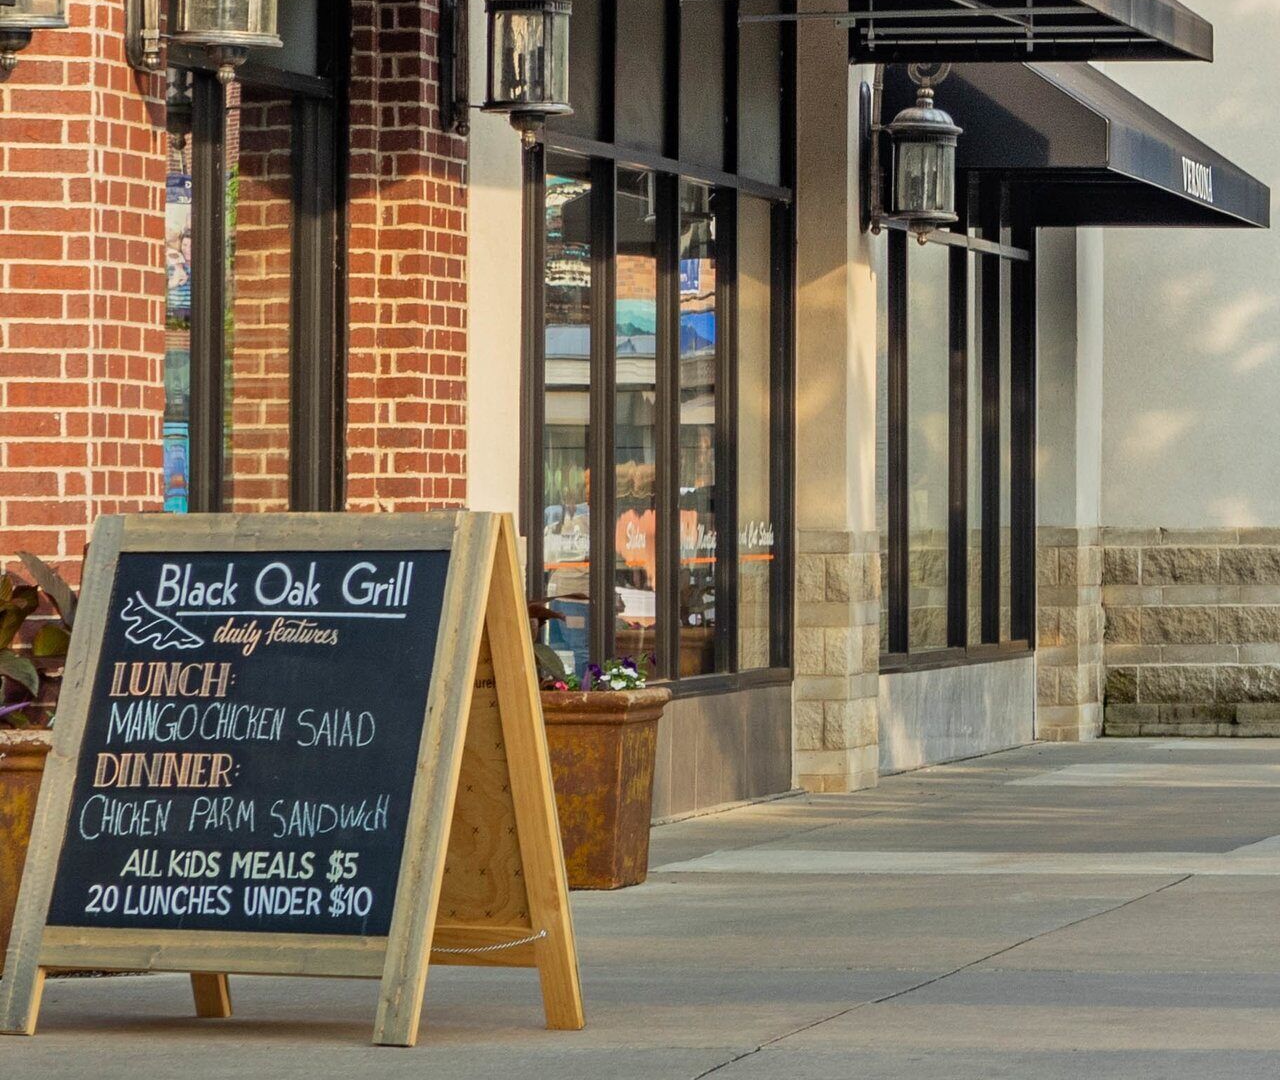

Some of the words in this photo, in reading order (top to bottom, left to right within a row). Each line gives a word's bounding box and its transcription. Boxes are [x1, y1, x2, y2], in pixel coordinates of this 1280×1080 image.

[1181, 155, 1214, 204] VERSONA
[155, 562, 239, 608] Black
[254, 561, 321, 607] Oak
[341, 561, 414, 607] Grill
[212, 617, 263, 656] daily
[264, 619, 339, 647] features
[108, 661, 236, 698] LUNCH:
[105, 699, 199, 745] MANGO
[199, 701, 286, 742] CHICKEN
[296, 707, 376, 748] SALAD
[92, 751, 241, 788] DINNER:
[79, 794, 173, 840] CHICKEN
[188, 796, 255, 833] PARM
[119, 848, 163, 878] ALL
[229, 850, 316, 880] MEALS
[325, 849, 360, 884] $5
[84, 884, 119, 914] 20
[122, 884, 233, 916] LUNCHES
[242, 885, 322, 916] UNDER
[328, 883, 373, 918] $10
